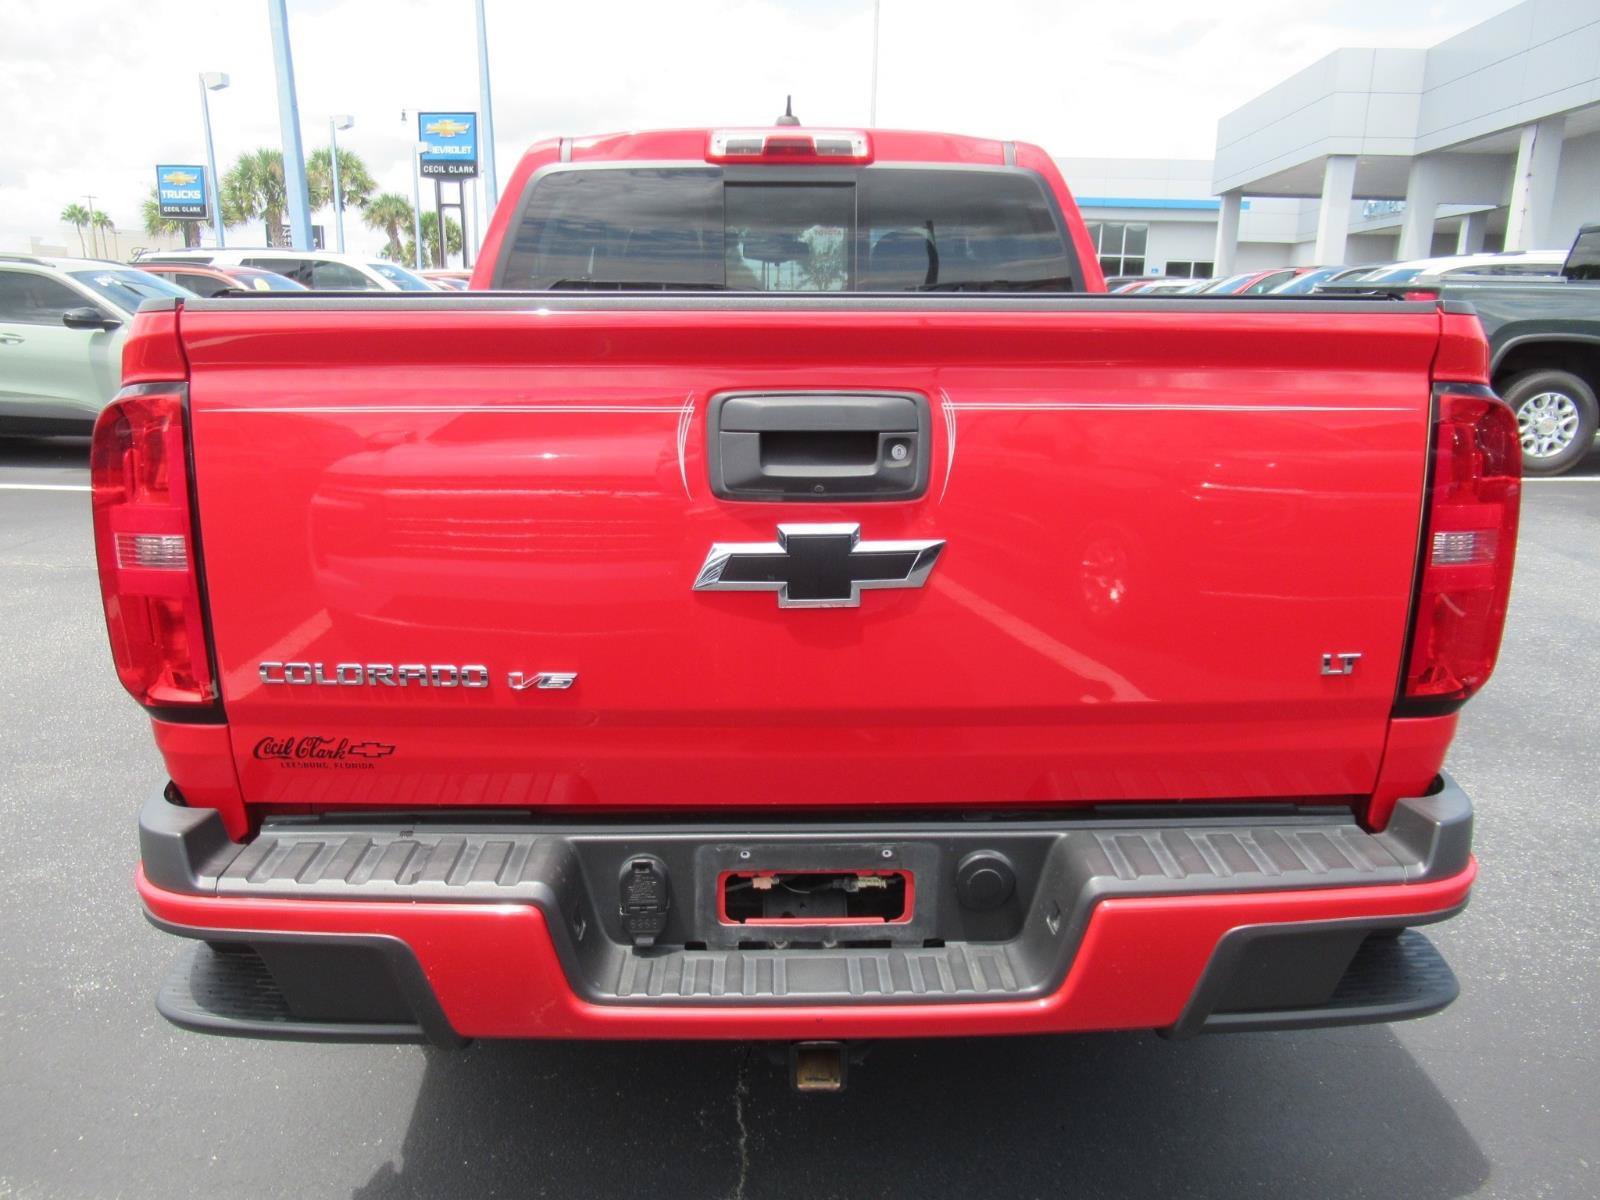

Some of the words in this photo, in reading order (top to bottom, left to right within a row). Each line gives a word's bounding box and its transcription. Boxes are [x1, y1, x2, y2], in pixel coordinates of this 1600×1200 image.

[429, 145, 473, 154] HEVROLET
[423, 165, 446, 174] CECIL
[448, 165, 474, 174] CLARK
[161, 190, 201, 200] TRUCKS
[1320, 652, 1362, 676] LT
[258, 661, 489, 688] COLORADO
[507, 671, 578, 690] V6
[252, 736, 296, 760] Cecil
[295, 736, 349, 760] Clark
